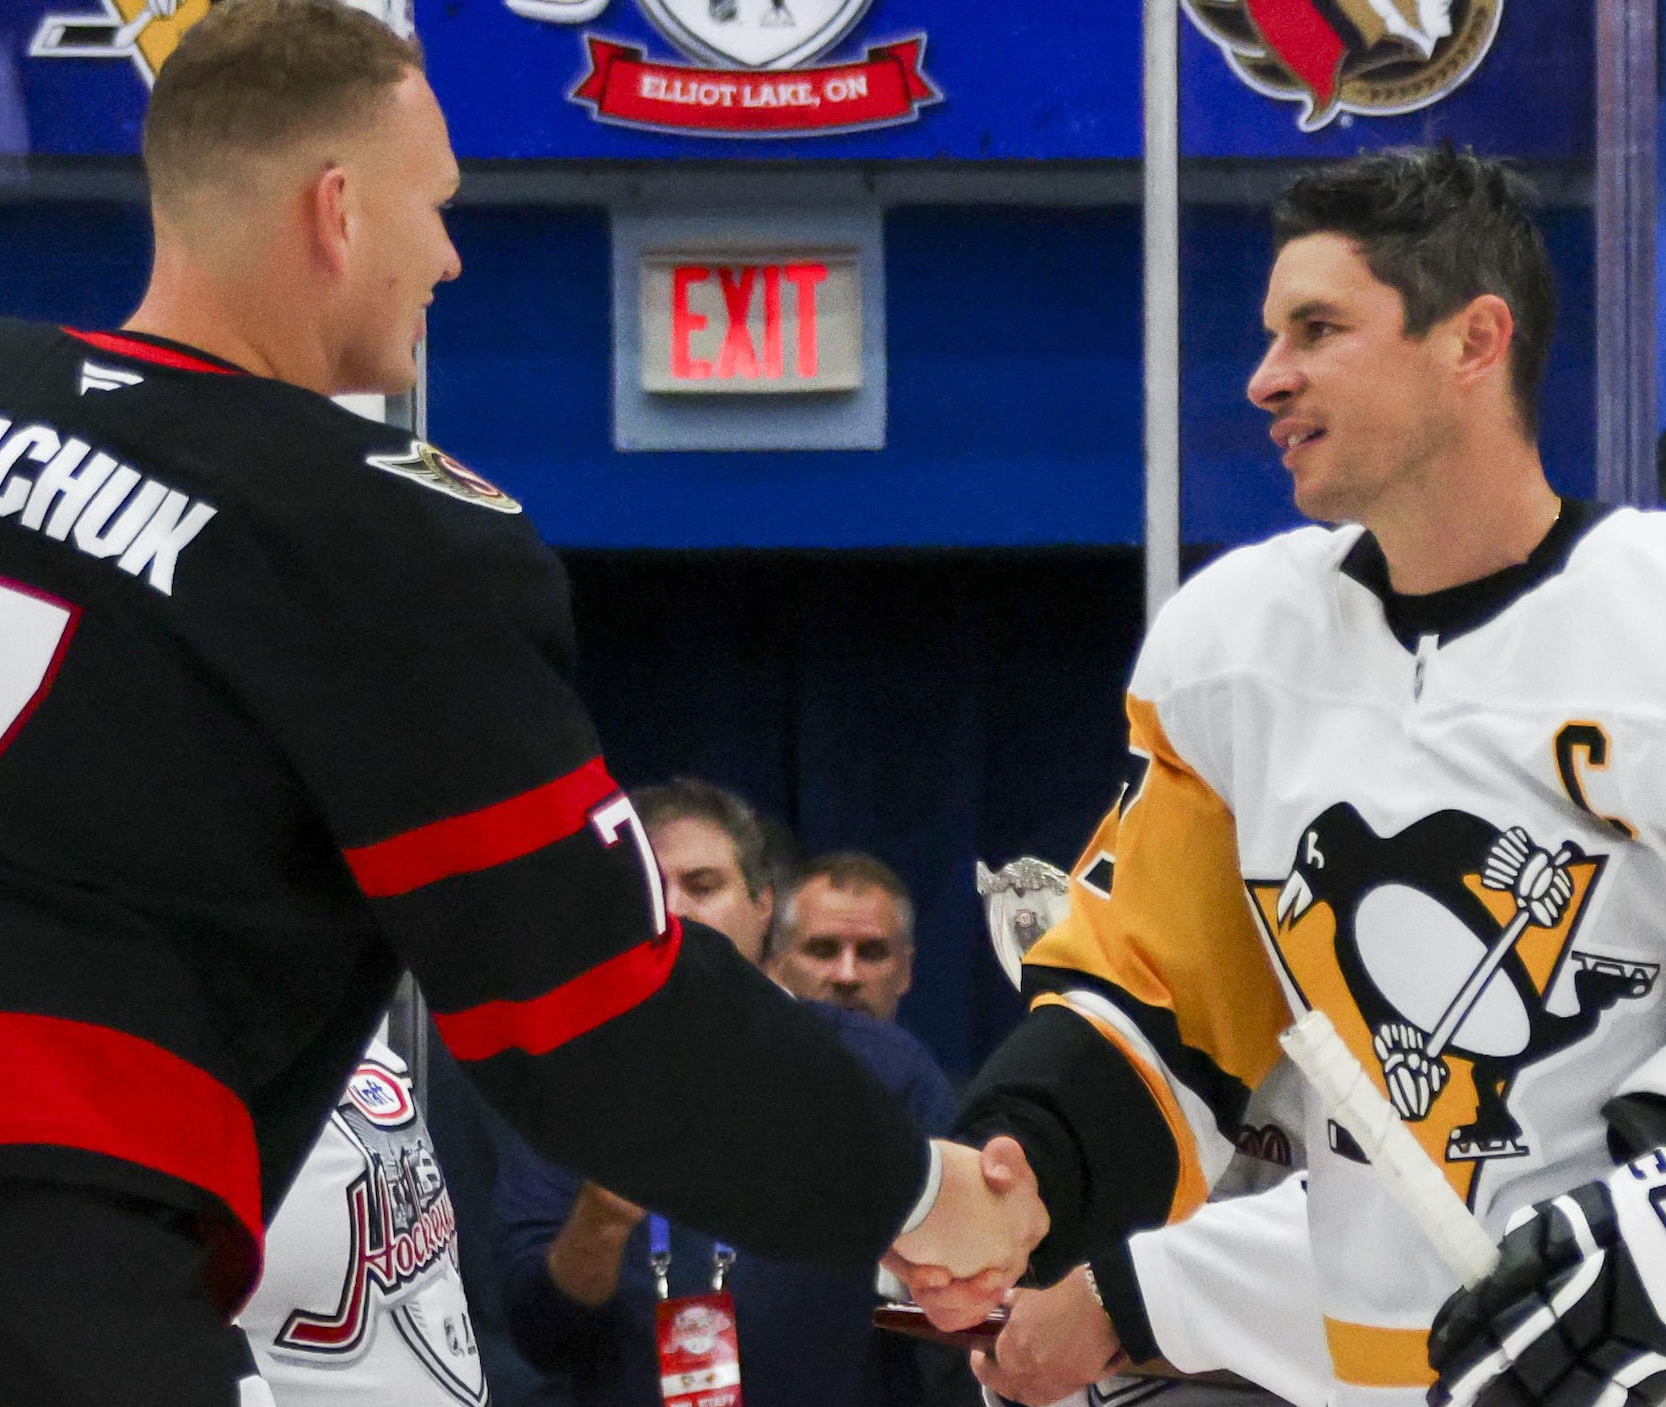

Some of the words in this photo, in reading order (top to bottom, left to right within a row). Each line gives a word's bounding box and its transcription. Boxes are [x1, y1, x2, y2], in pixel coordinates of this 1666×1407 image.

[639, 75, 737, 106] ELLIOT
[742, 83, 821, 109] LAKE,
[826, 75, 867, 100] ON
[670, 263, 828, 380] EXIT
[1553, 720, 1639, 840] C
[587, 793, 667, 935] 7
